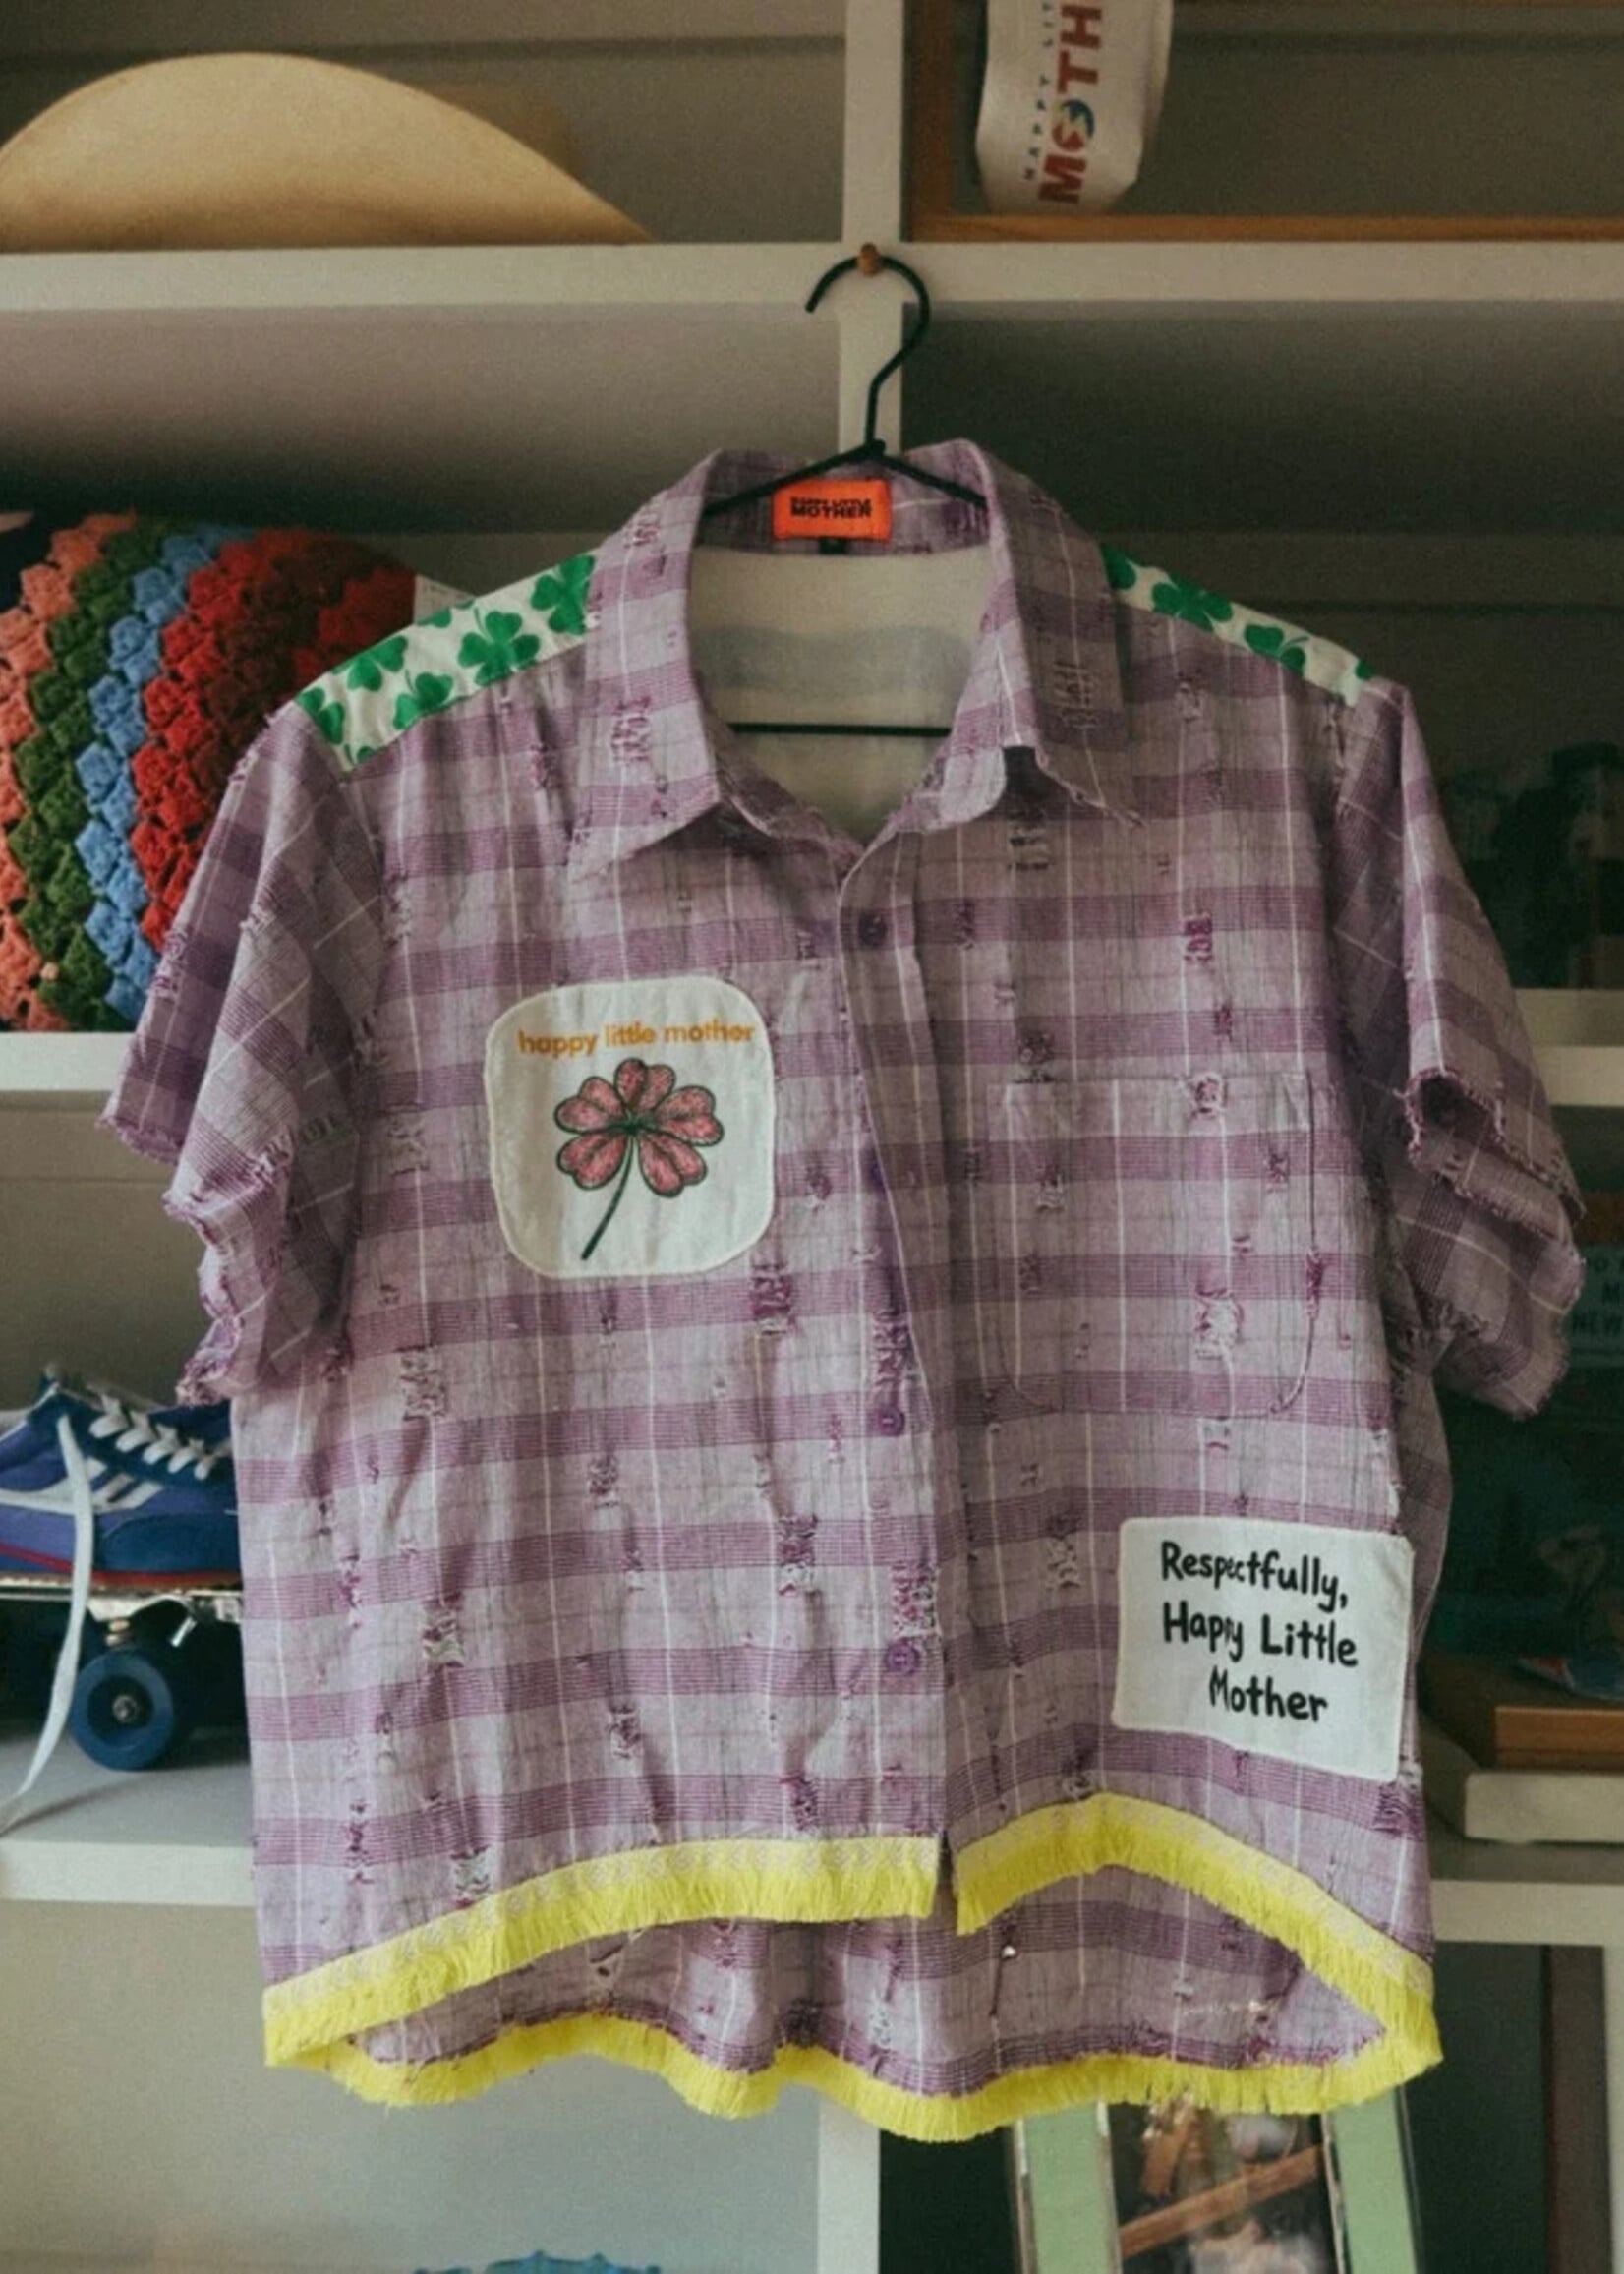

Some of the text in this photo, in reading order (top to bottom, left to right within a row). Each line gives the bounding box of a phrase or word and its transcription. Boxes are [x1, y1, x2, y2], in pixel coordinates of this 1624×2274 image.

[1023, 74, 1050, 181] HAPPY
[790, 503, 872, 519] MOTHER
[518, 1017, 755, 1057] happy little mother
[1161, 1540, 1348, 1614] Respectfully,
[1261, 1613, 1358, 1667] Little
[1209, 1665, 1329, 1722] Mother
